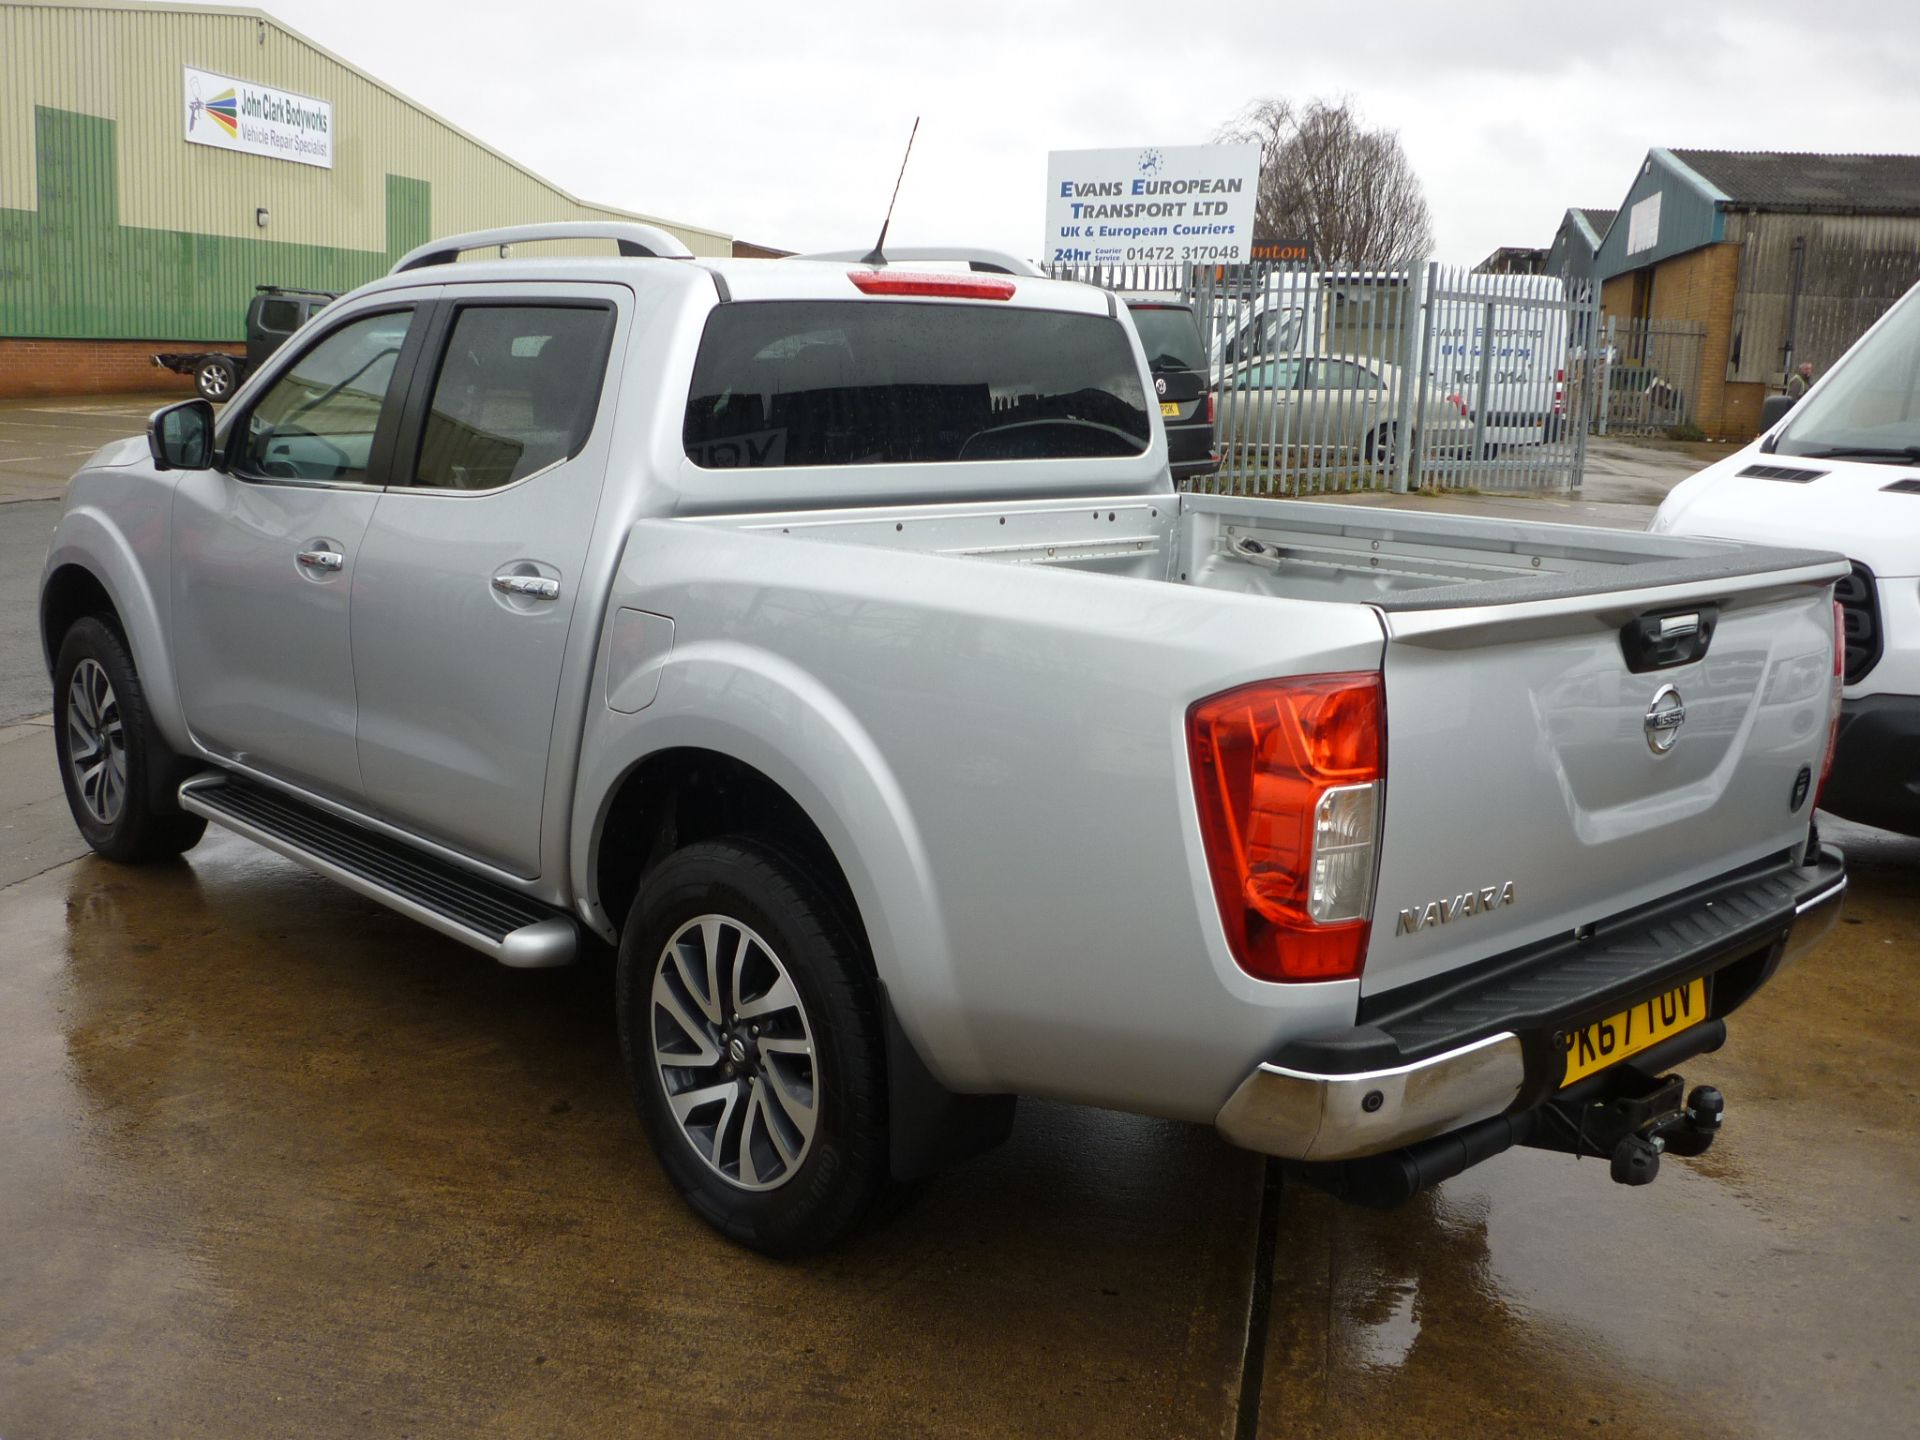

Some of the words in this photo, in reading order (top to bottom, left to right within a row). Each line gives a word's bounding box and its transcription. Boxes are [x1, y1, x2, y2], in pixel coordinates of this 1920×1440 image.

[241, 89, 262, 118] John
[263, 94, 285, 124] Clark
[286, 99, 328, 134] Bodyworks
[241, 123, 269, 145] Vehicle
[270, 129, 294, 151] Repair
[294, 134, 327, 157] Specialist
[1060, 181, 1122, 197] EVANS
[1131, 178, 1243, 196] EUROPEAN
[1070, 202, 1187, 220] TRANSPORT
[1192, 201, 1229, 217] LTD
[1060, 226, 1081, 237] UK
[1084, 226, 1094, 237] &
[1099, 225, 1168, 239] European
[1172, 224, 1236, 236] Couriers
[1054, 248, 1092, 261] 24hr
[1094, 254, 1121, 262] Service
[1095, 247, 1122, 255] Courier
[1126, 246, 1174, 261] 01472
[1181, 244, 1239, 260] 317048
[1395, 880, 1515, 937] NAVARA
